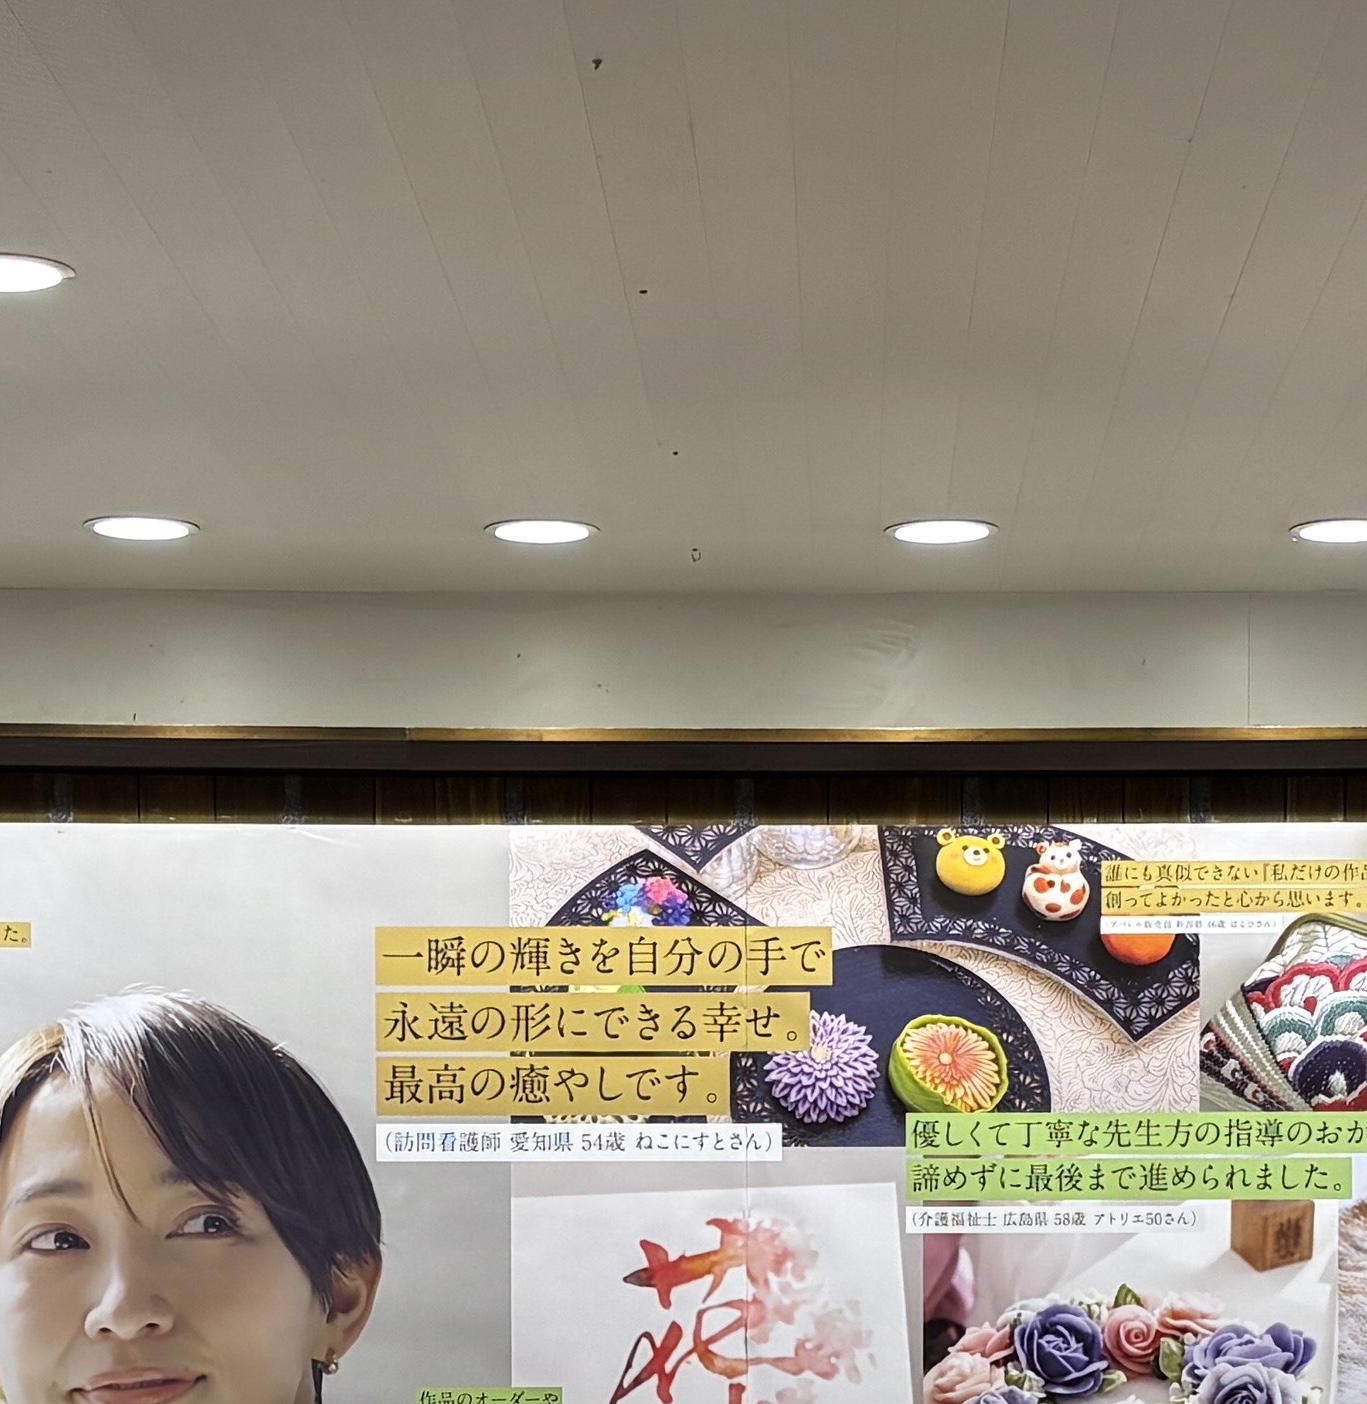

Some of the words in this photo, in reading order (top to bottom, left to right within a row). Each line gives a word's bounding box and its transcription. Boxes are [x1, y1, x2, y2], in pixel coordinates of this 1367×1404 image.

[1106, 892, 1362, 909] 創ってよかったと心から思います。
[383, 936, 827, 976] 一瞬の輝きを自分の手で
[385, 1002, 799, 1042] 永遠の形にできる幸せ。
[384, 1066, 719, 1105] 最高の癒やしです。
[510, 1132, 573, 1151] 愛知県
[582, 1132, 624, 1151] 54歳
[912, 1163, 1344, 1192] 諦めずに最後まで進められました。
[1003, 1211, 1048, 1227] 広島県
